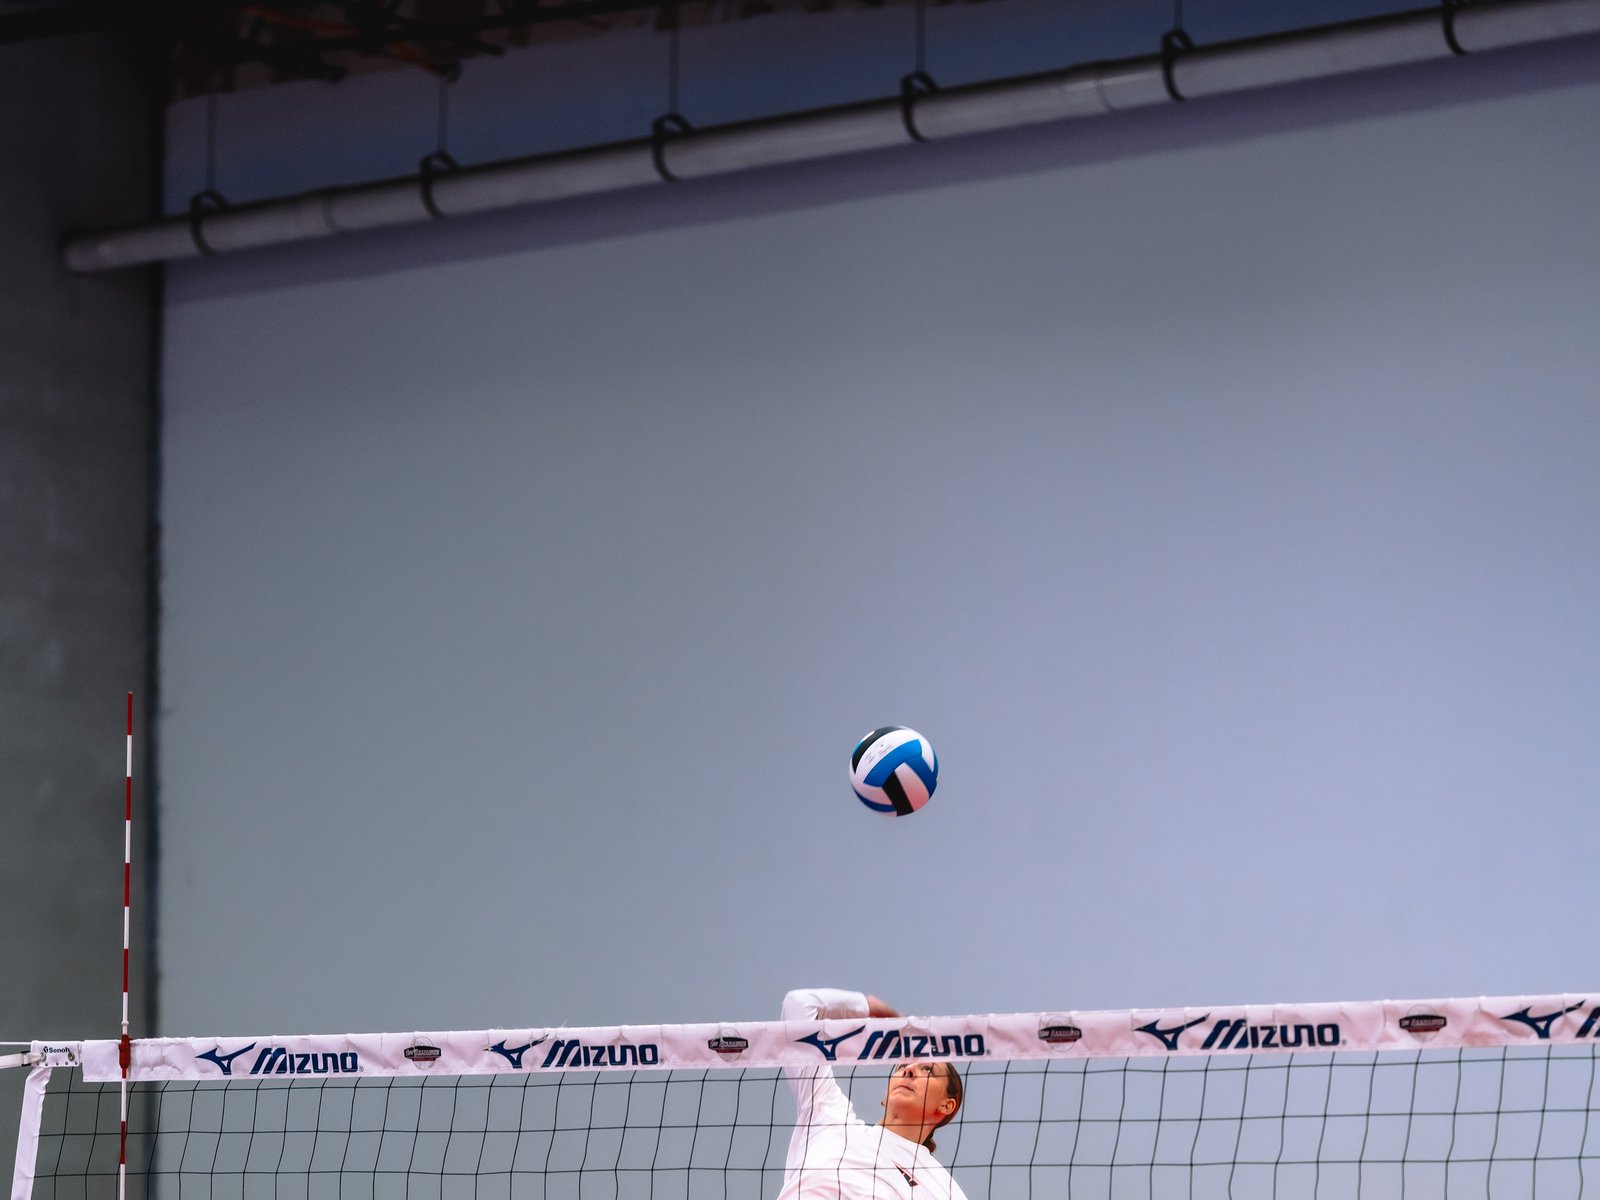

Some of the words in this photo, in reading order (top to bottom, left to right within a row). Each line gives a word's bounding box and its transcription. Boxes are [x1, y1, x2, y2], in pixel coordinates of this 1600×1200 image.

[857, 1029, 985, 1060] MIZUNO
[1200, 1019, 1340, 1050] MIZUNO
[250, 1047, 359, 1075] MIZUNO
[540, 1039, 659, 1068] MIZUNO
